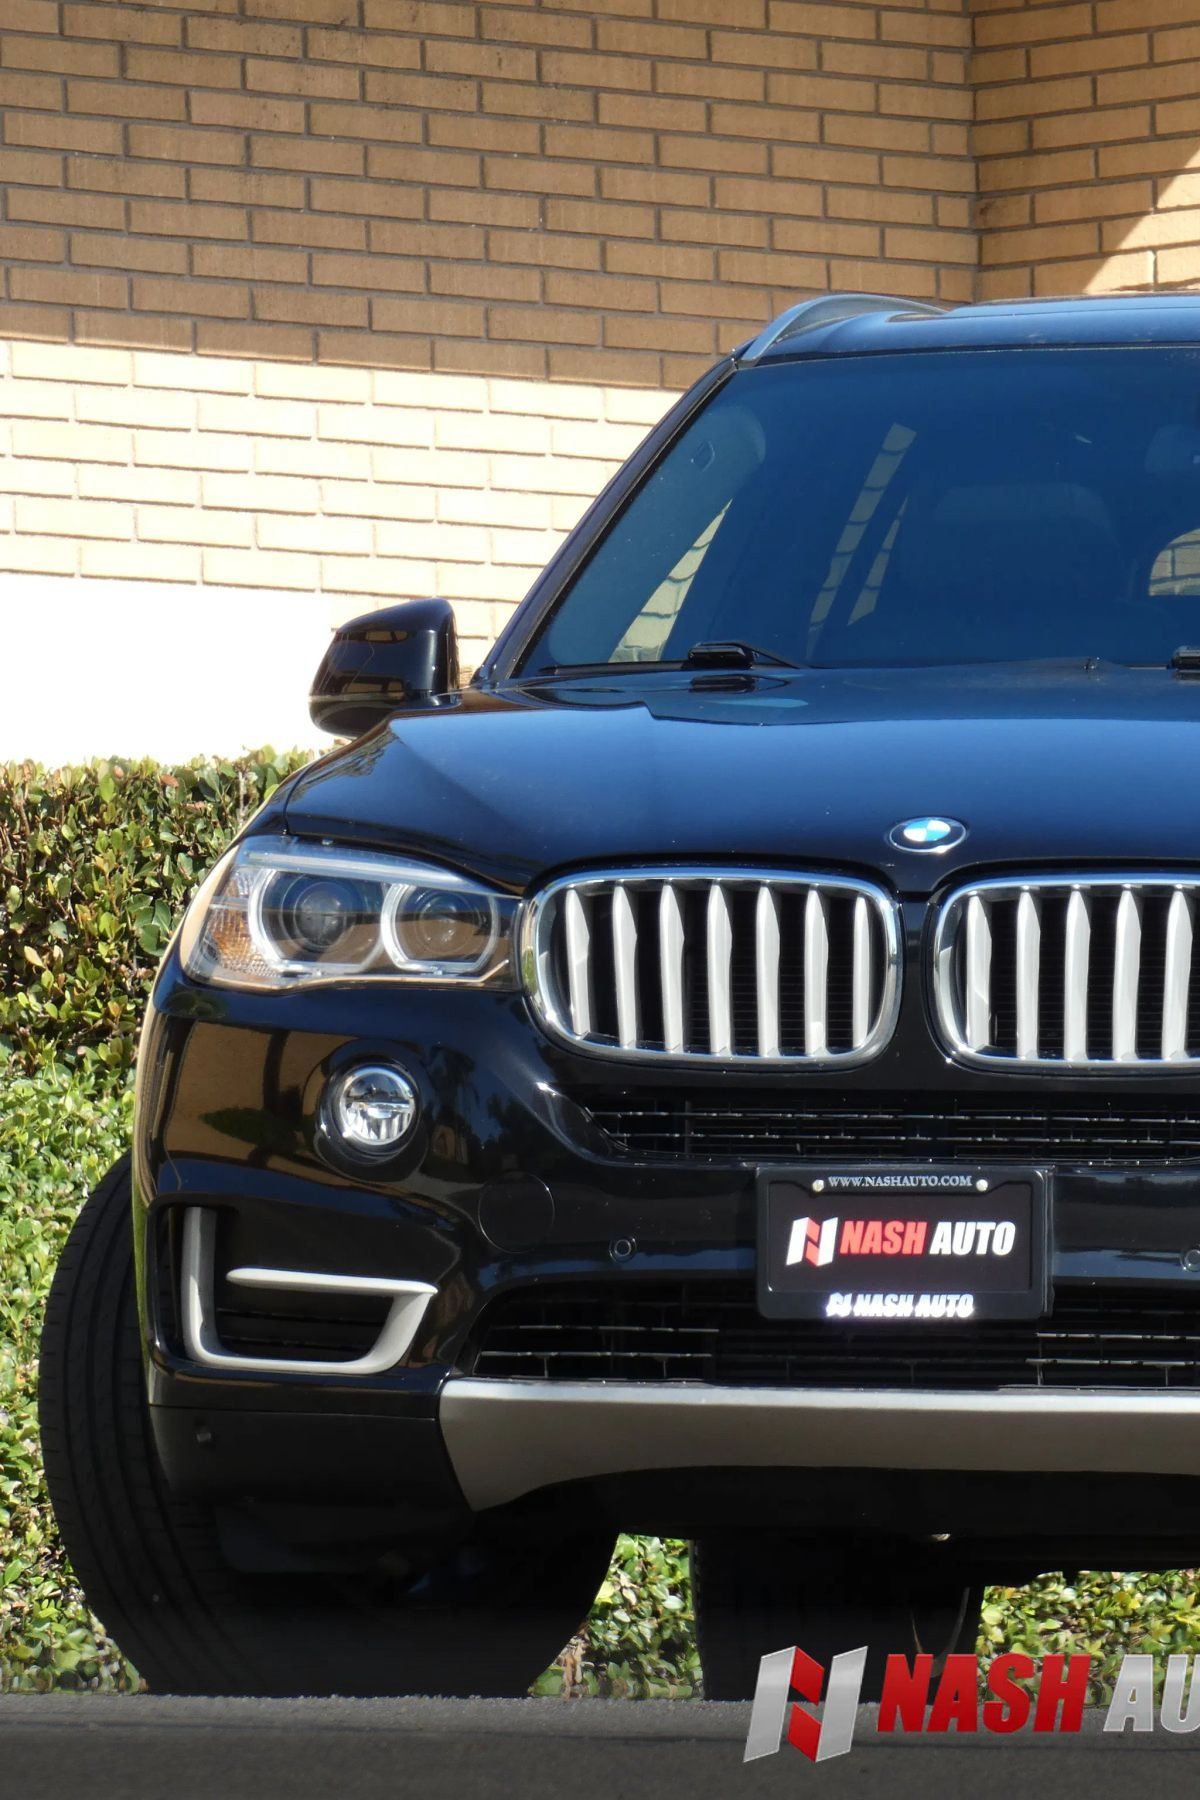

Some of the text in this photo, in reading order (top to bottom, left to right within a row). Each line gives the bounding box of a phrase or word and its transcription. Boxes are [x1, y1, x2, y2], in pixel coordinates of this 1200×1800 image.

[827, 1175, 972, 1187] WWW.NASHAUTO.COM
[840, 1221, 928, 1255] NASH
[929, 1222, 1016, 1256] AUTO
[853, 1294, 914, 1317] NASH
[914, 1294, 974, 1318] AUTO
